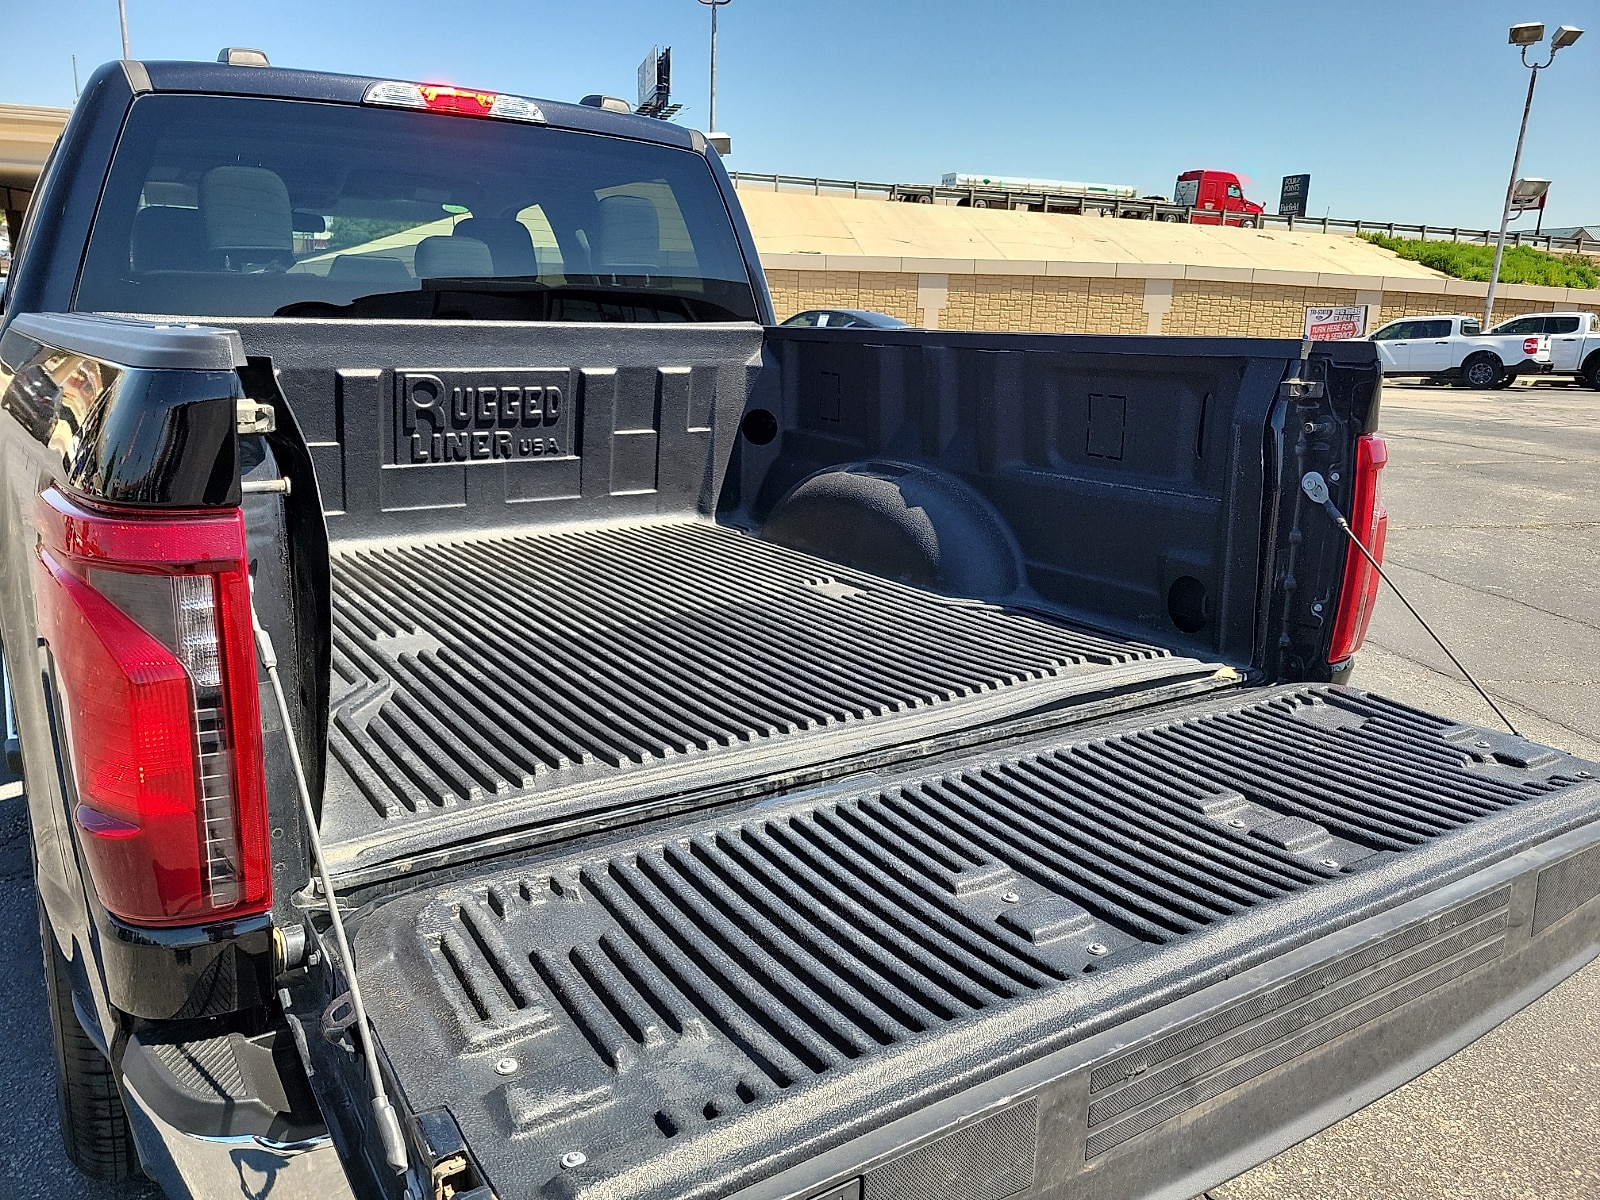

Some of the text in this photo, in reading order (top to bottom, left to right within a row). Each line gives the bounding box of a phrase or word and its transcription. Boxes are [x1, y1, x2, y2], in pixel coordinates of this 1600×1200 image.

[1280, 202, 1299, 211] Fairfield
[1312, 323, 1353, 334] TURN HERE FOR
[1331, 331, 1353, 339] SERVICE
[403, 374, 562, 437] RUGGED
[411, 431, 561, 463] LINER USA
